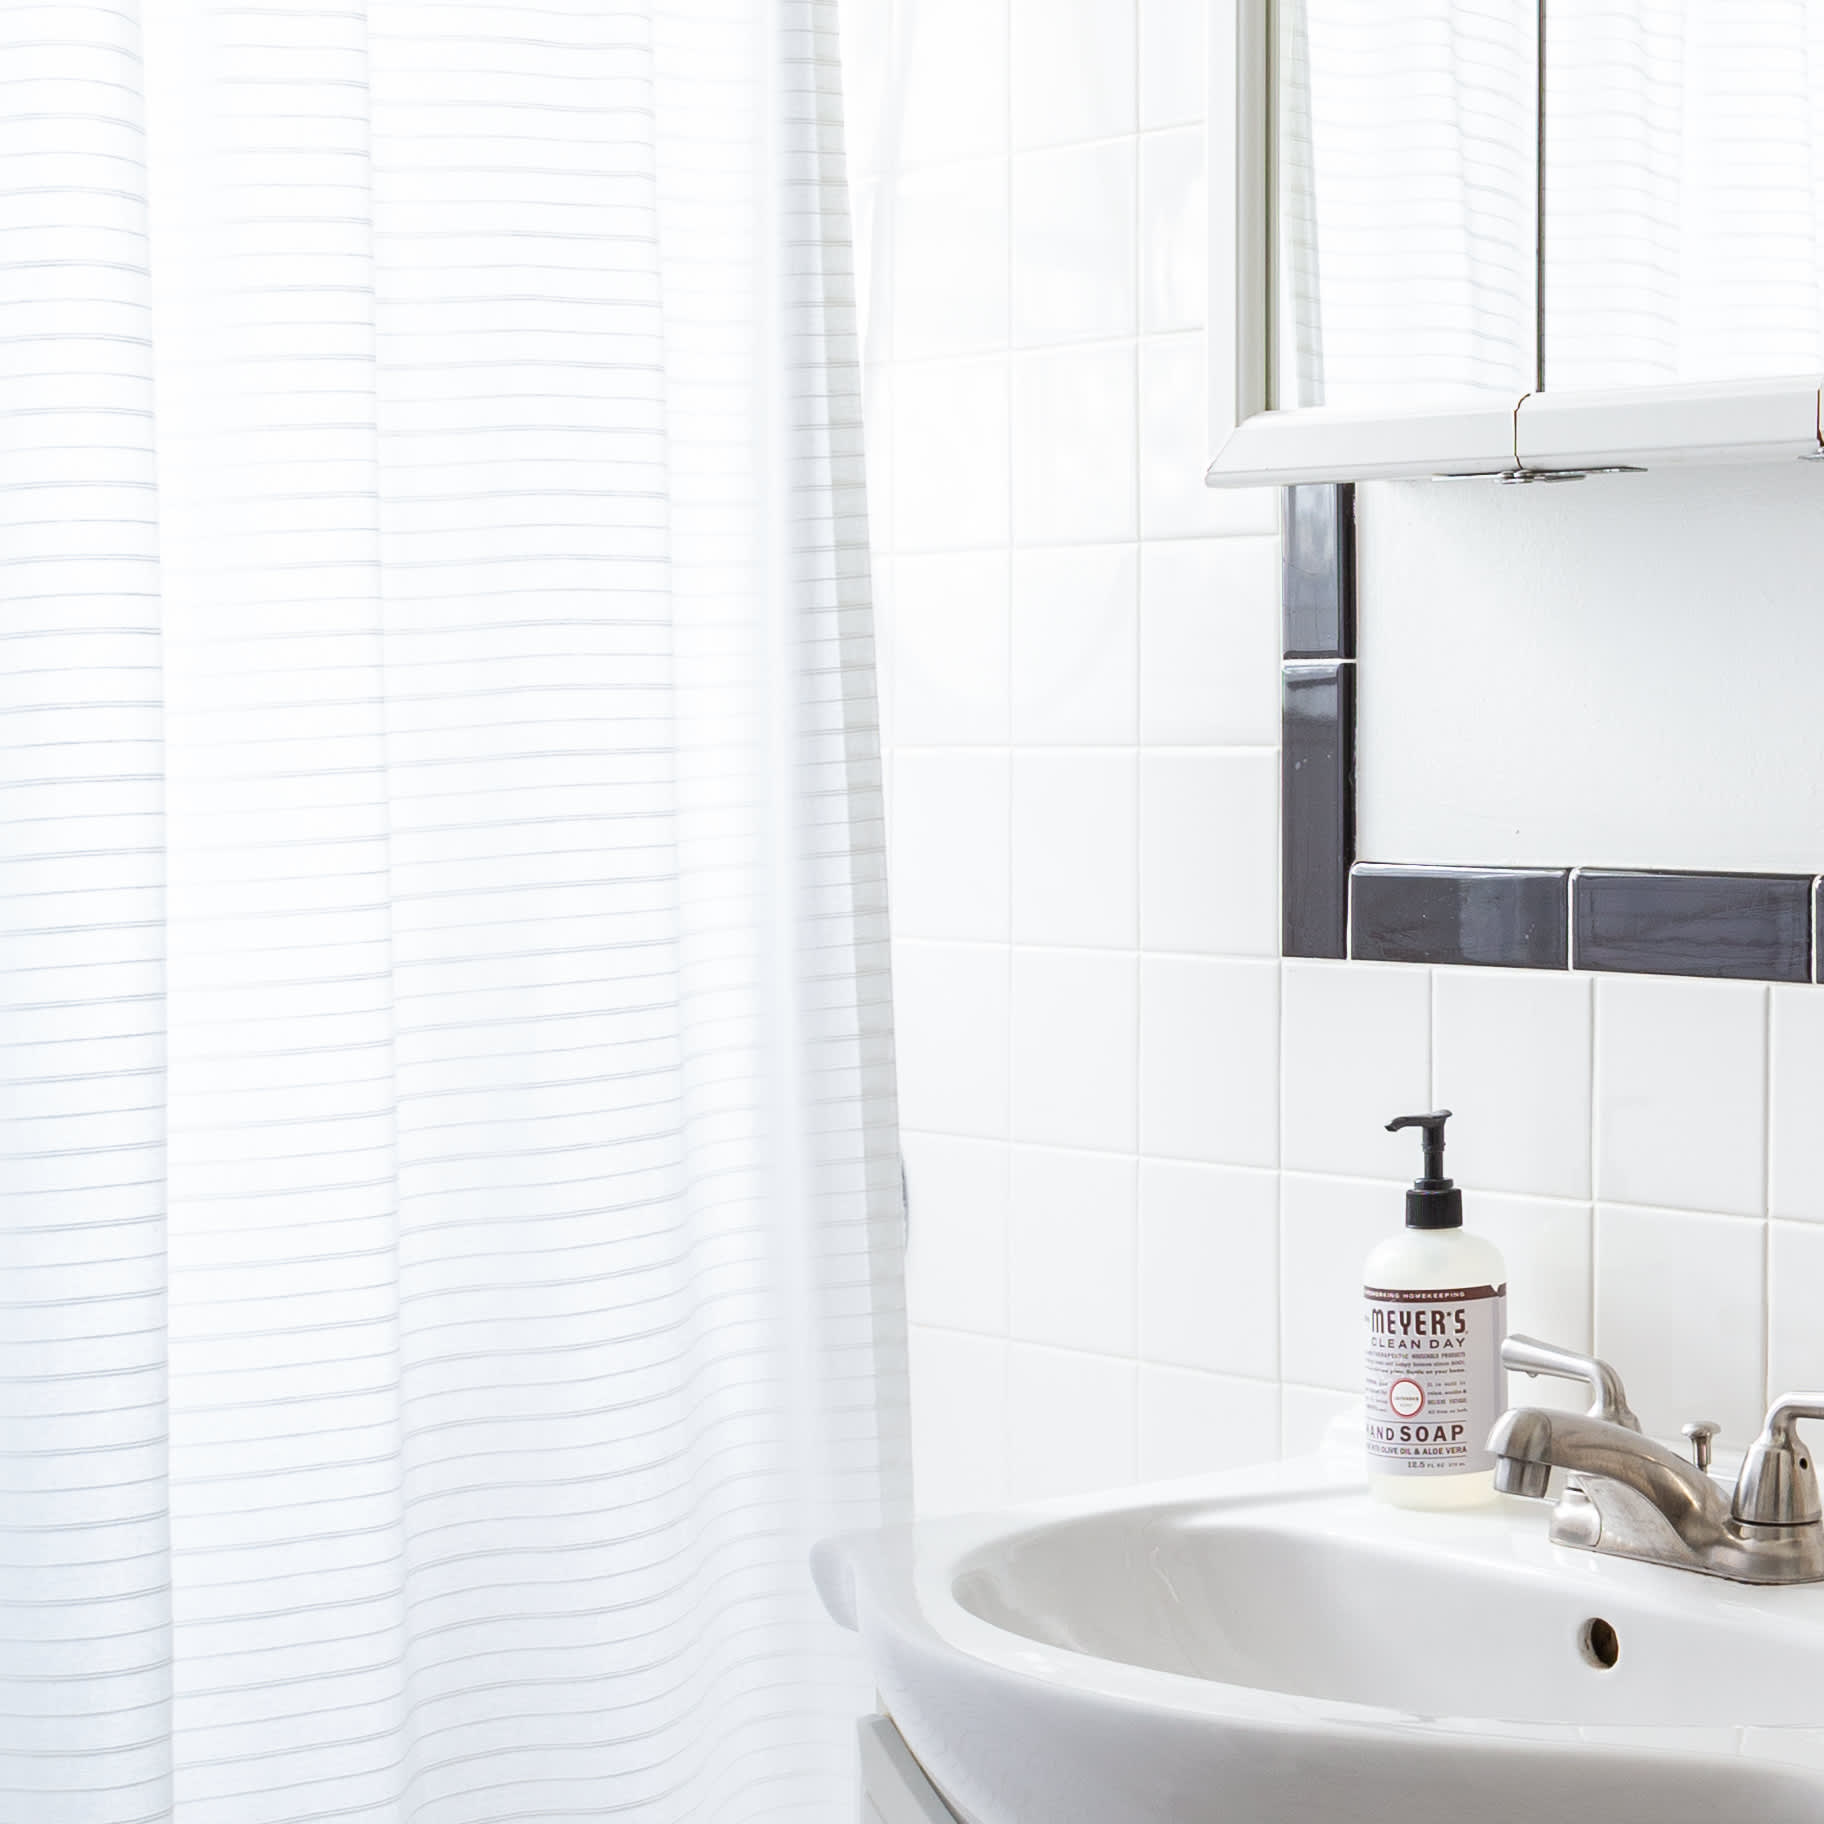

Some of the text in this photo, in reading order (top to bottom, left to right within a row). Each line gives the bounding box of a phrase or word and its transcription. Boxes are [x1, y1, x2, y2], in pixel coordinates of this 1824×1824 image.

[1371, 1308, 1466, 1336] MEYER'S
[1371, 1337, 1465, 1349] CLEAN DAY
[1400, 1424, 1464, 1442] SOAP
[1399, 1447, 1412, 1455] OIL
[1422, 1447, 1443, 1455] ALOE
[1446, 1446, 1467, 1455] VERA
